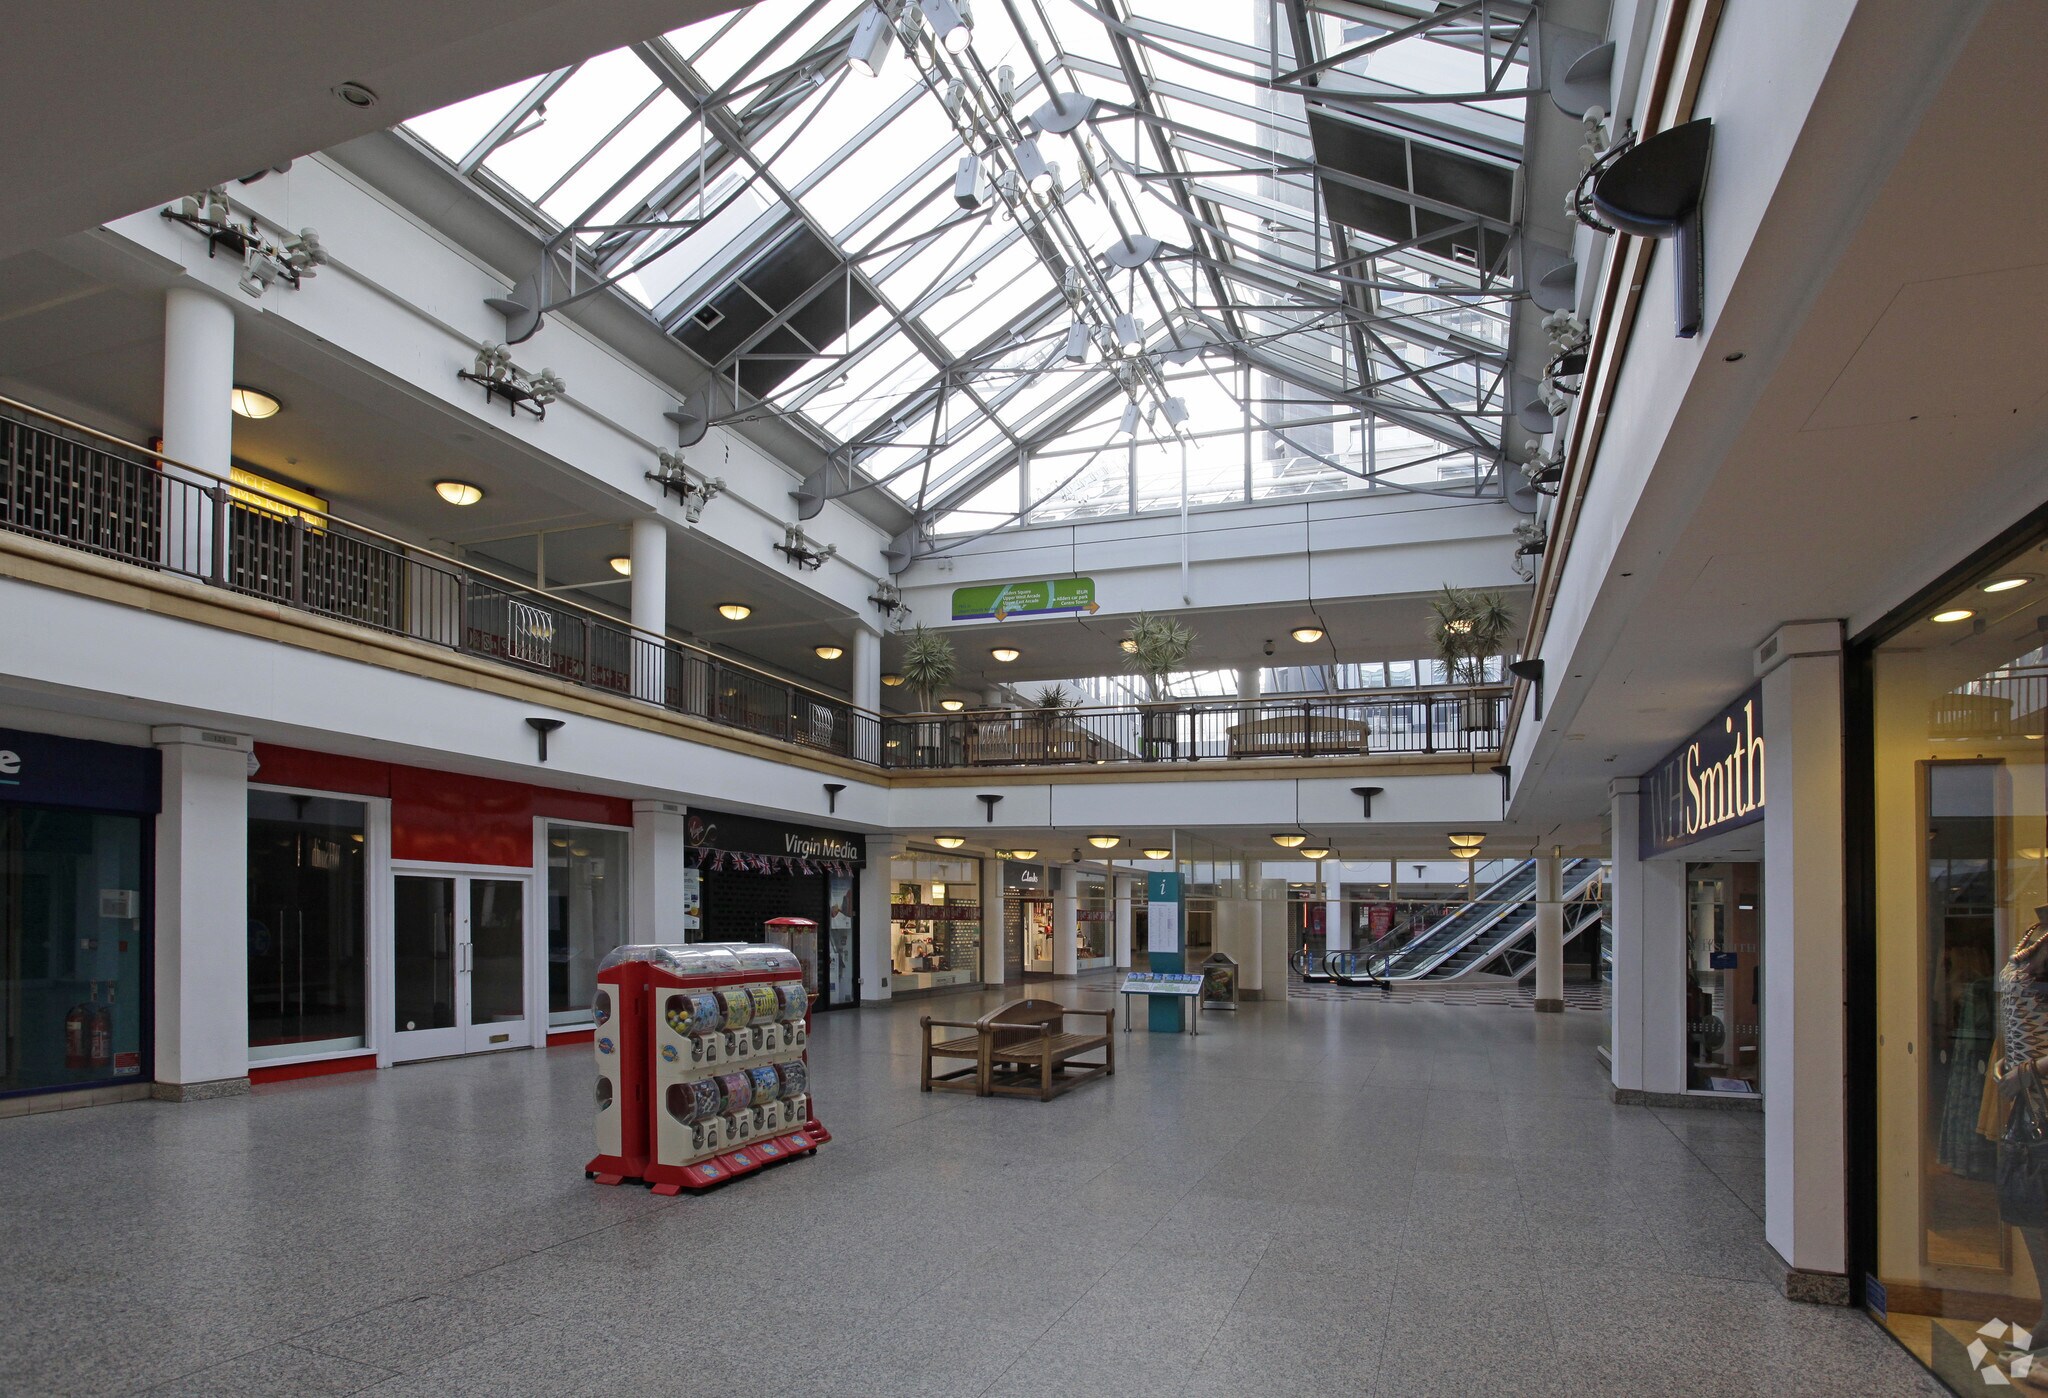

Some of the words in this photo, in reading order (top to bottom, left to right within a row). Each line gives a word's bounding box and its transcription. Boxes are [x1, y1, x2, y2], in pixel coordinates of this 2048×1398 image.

[785, 833, 820, 860] Virgin
[823, 838, 858, 861] Media
[1021, 869, 1039, 883] Clarks
